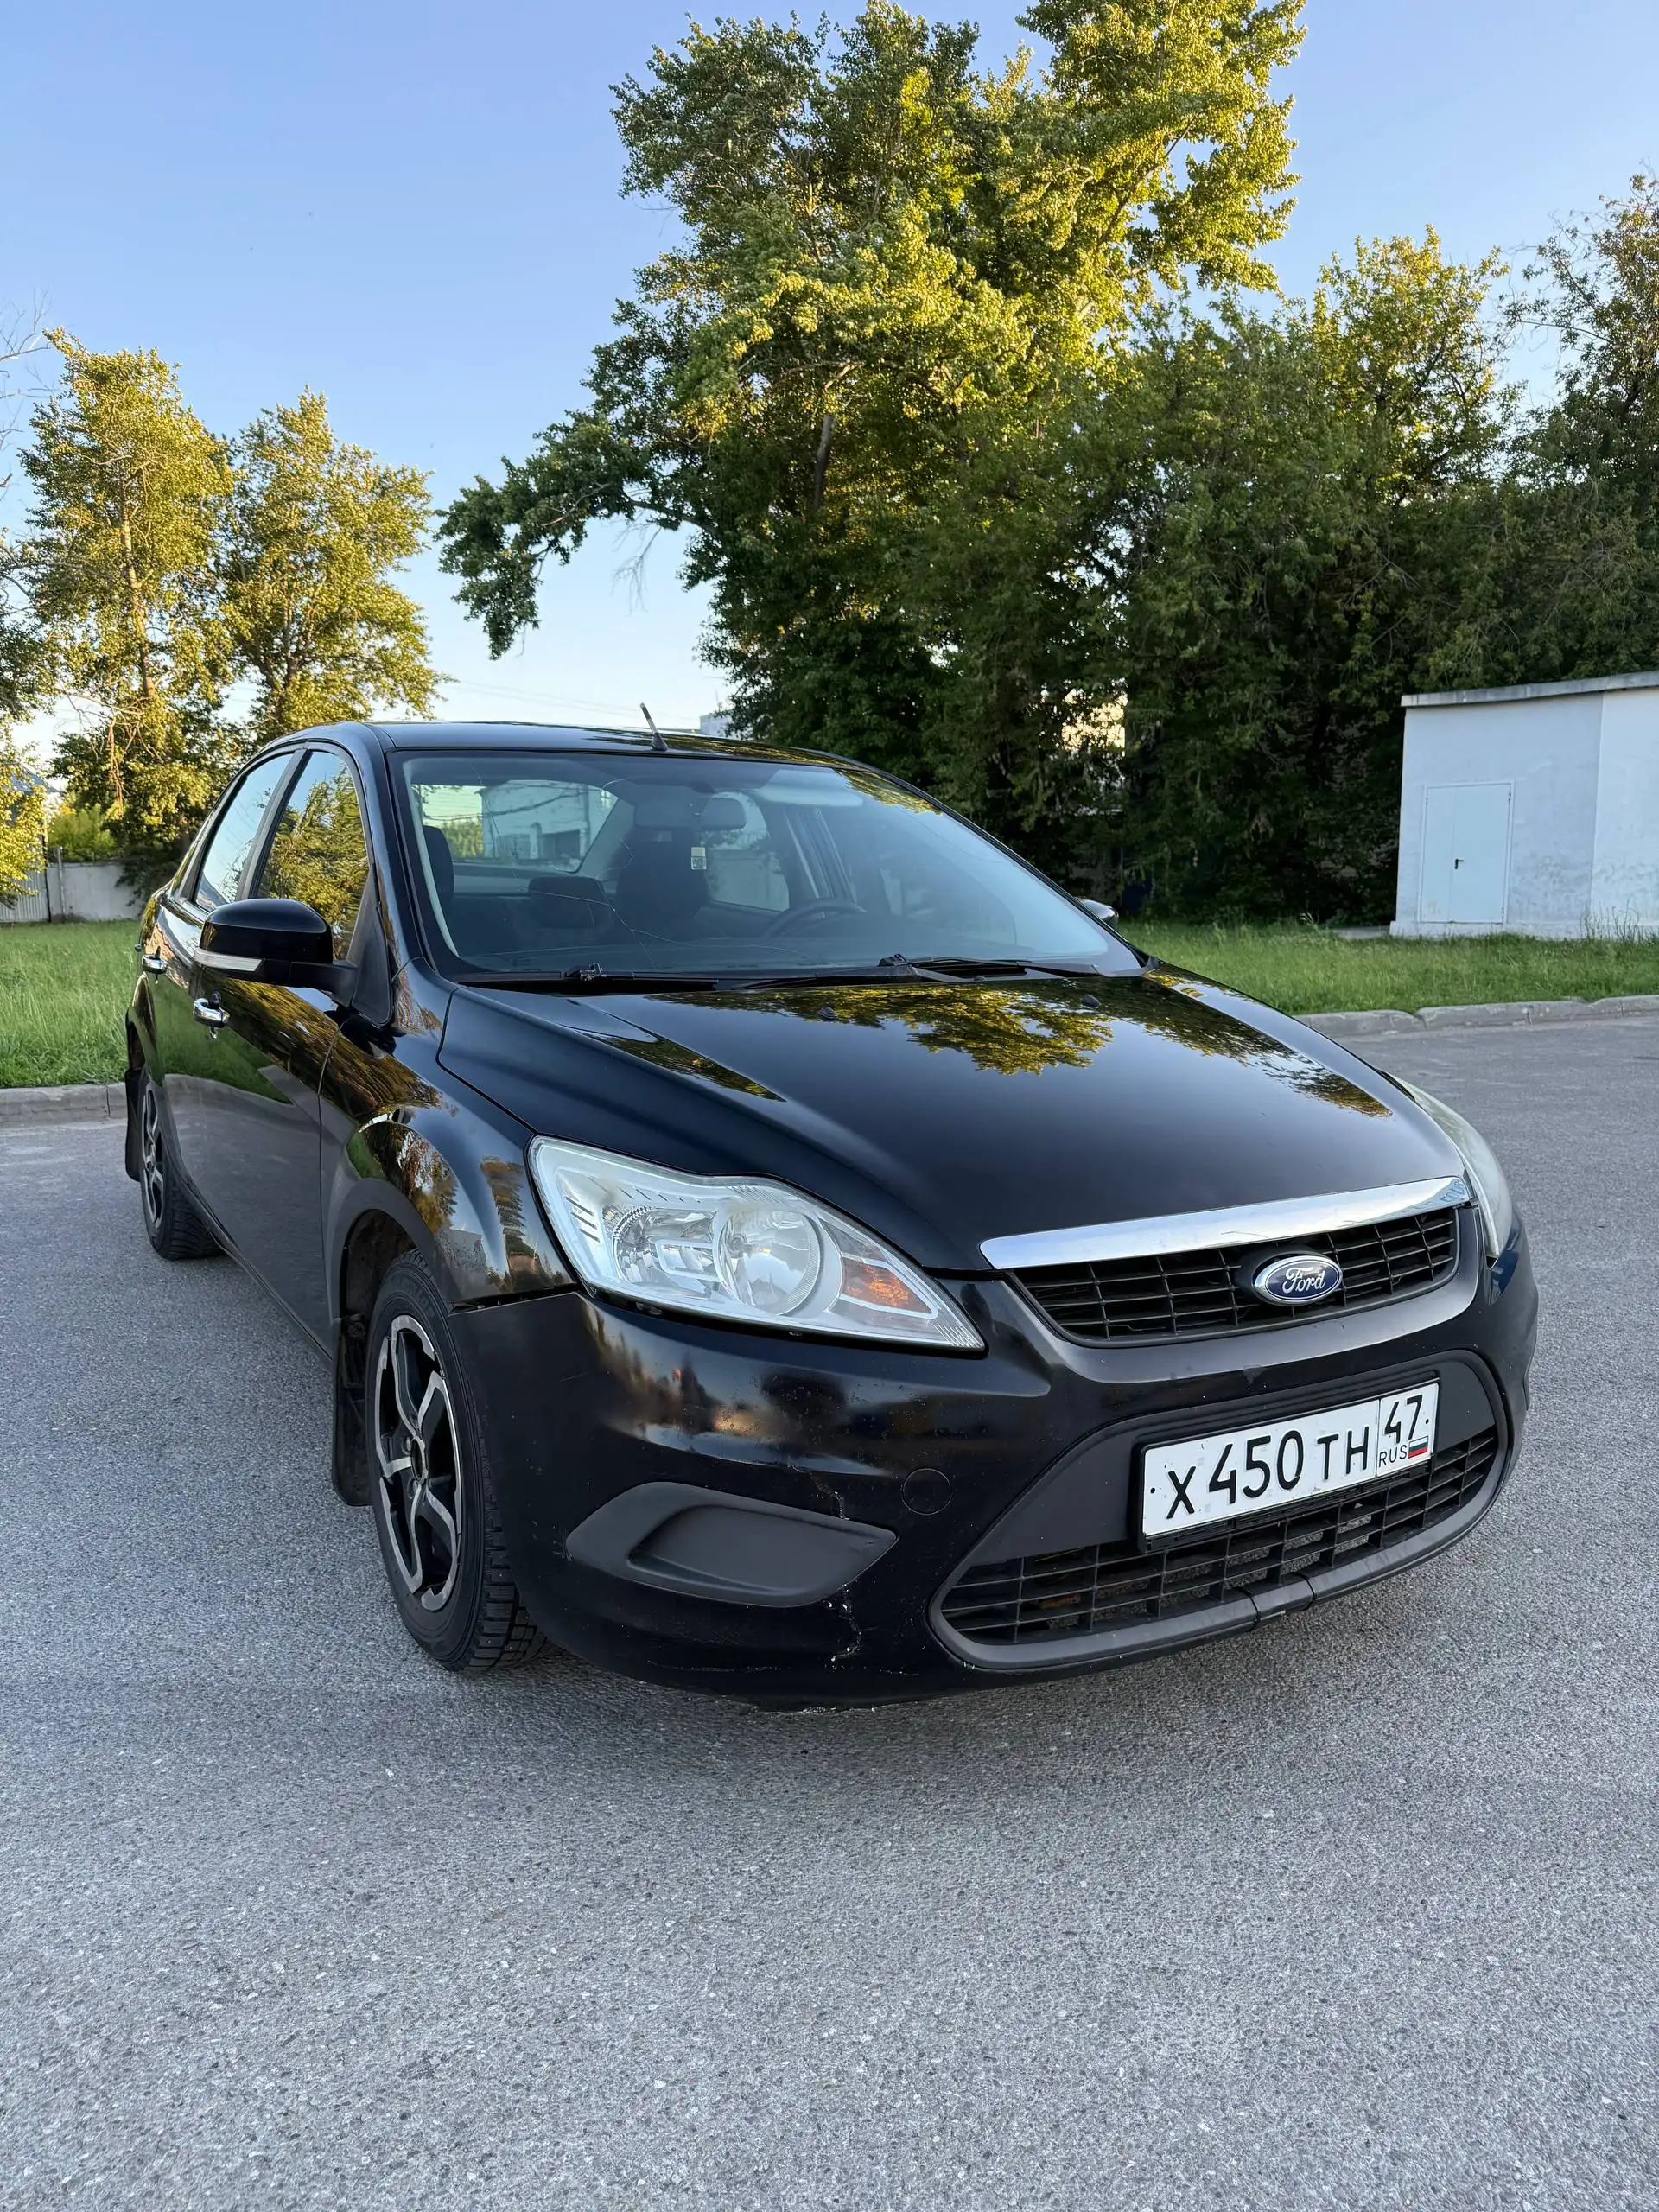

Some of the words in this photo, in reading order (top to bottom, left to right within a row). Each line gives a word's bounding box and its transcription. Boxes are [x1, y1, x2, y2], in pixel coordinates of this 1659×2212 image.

[1281, 1266, 1326, 1294] Ford
[1383, 1394, 1424, 1445] 47
[1379, 1444, 1408, 1468] RUS
